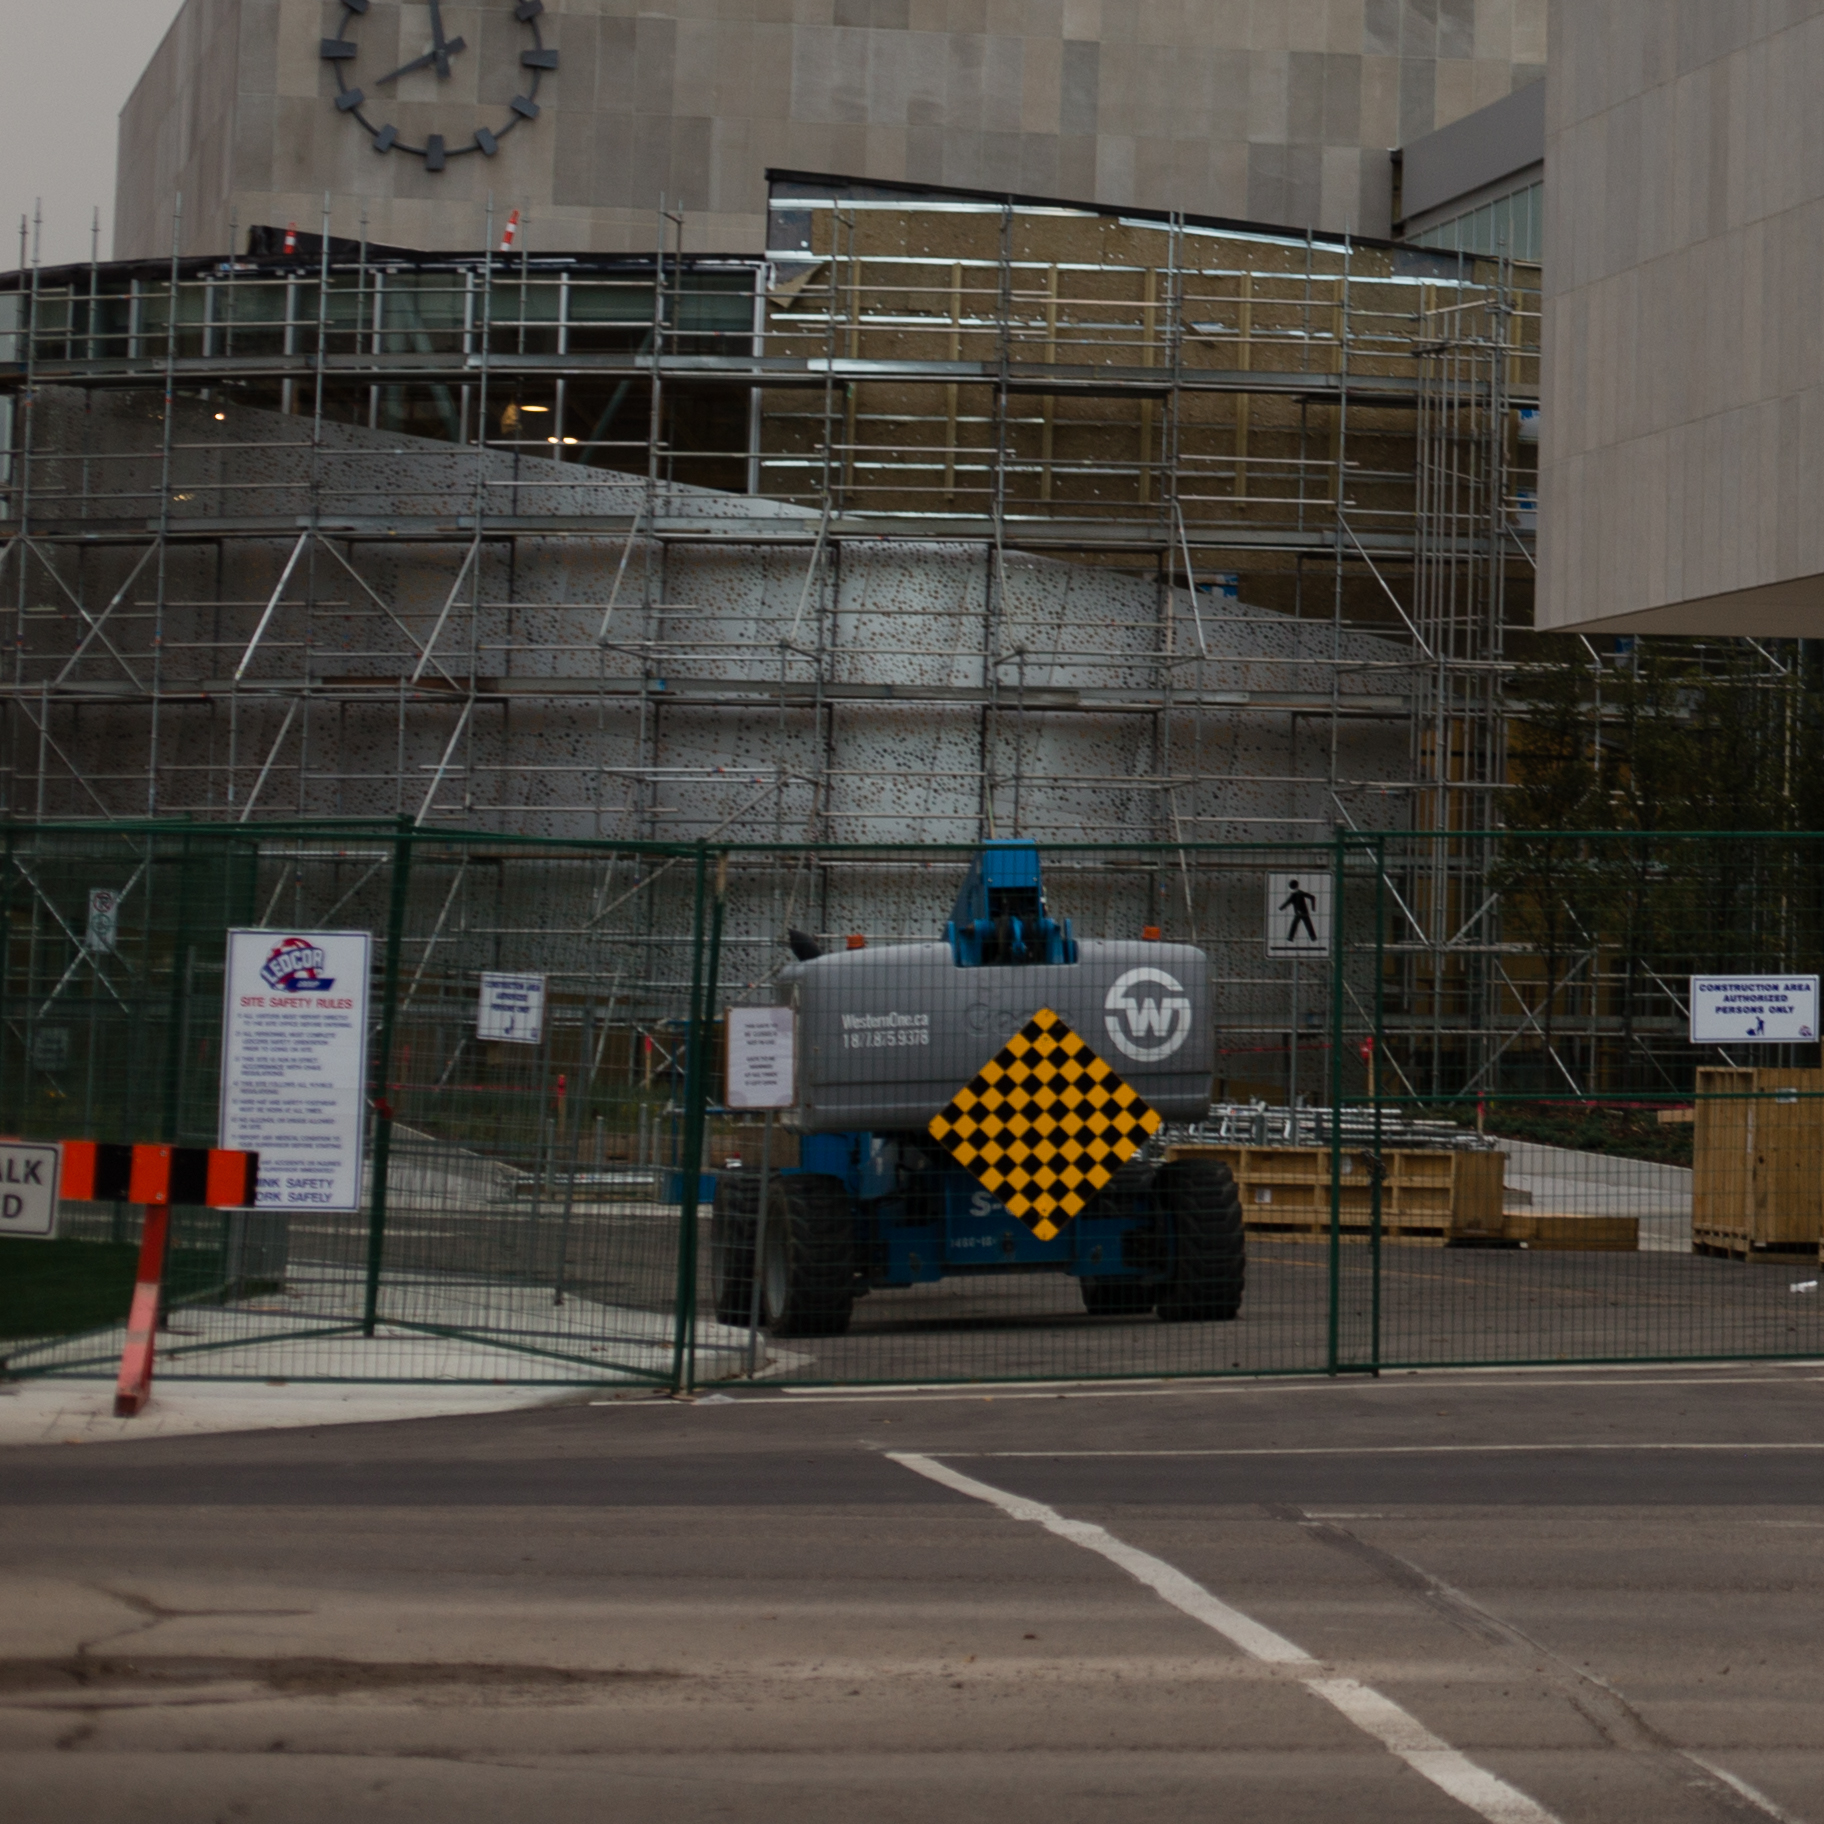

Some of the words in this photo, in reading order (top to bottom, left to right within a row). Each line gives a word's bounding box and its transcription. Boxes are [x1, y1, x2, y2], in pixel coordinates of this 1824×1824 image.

[261, 948, 323, 985] LEDCOR
[1699, 983, 1779, 992] CONSTRUCTION
[1783, 983, 1811, 992] AREA
[240, 996, 265, 1008] SITE
[269, 997, 312, 1009] SAFETY
[316, 998, 353, 1010] RULES
[1723, 994, 1788, 1003] AUTHORIZED
[1715, 1006, 1764, 1014] PERSONS
[1768, 1006, 1794, 1014] ONLY
[841, 1011, 929, 1030] WesternOne.ca
[285, 1178, 335, 1189] SAFETY
[256, 1192, 282, 1202] ORK
[286, 1192, 333, 1203] SAFELY
